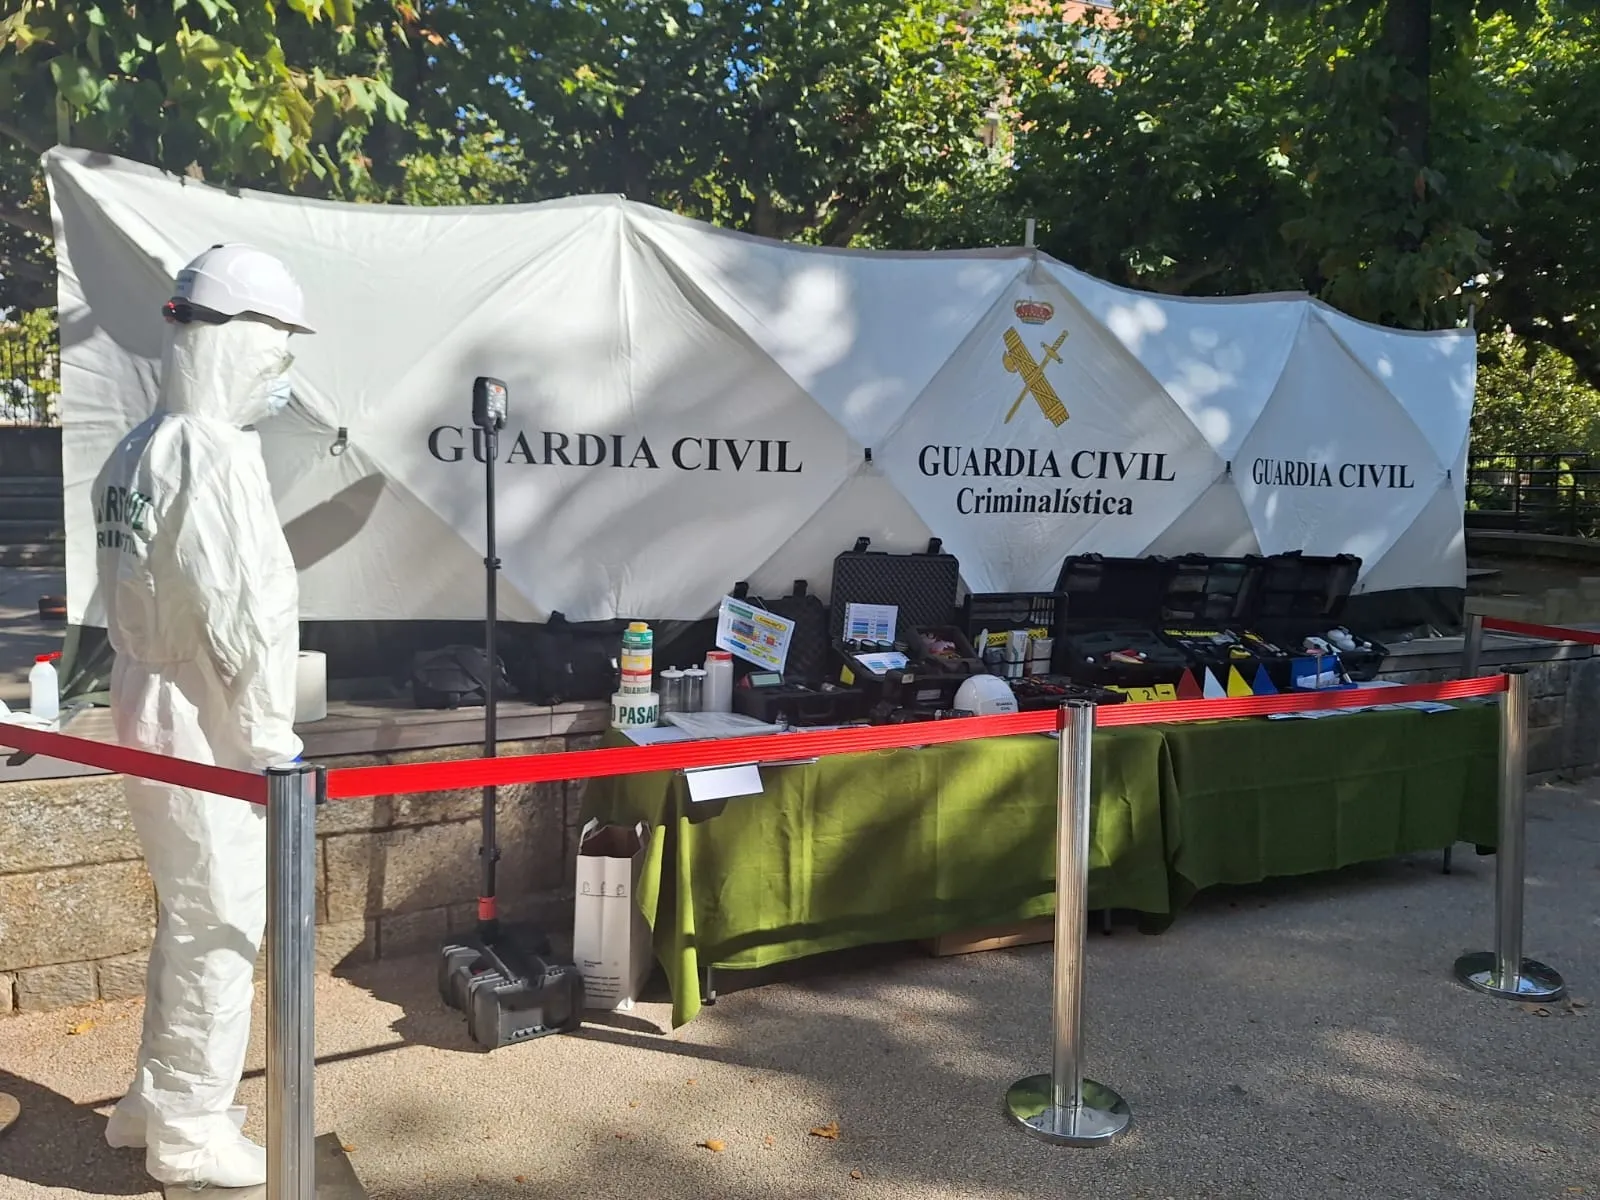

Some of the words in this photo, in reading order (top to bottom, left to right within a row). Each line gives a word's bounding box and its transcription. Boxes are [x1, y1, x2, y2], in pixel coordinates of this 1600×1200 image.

[428, 425, 660, 469] GUARDIA
[672, 436, 803, 473] CIVIL
[918, 445, 1062, 478] GUARDIA
[1070, 450, 1176, 482] CIVIL
[1252, 457, 1333, 487] GUARDIA
[1339, 463, 1415, 489] CIVIL
[956, 487, 1134, 516] Criminalística
